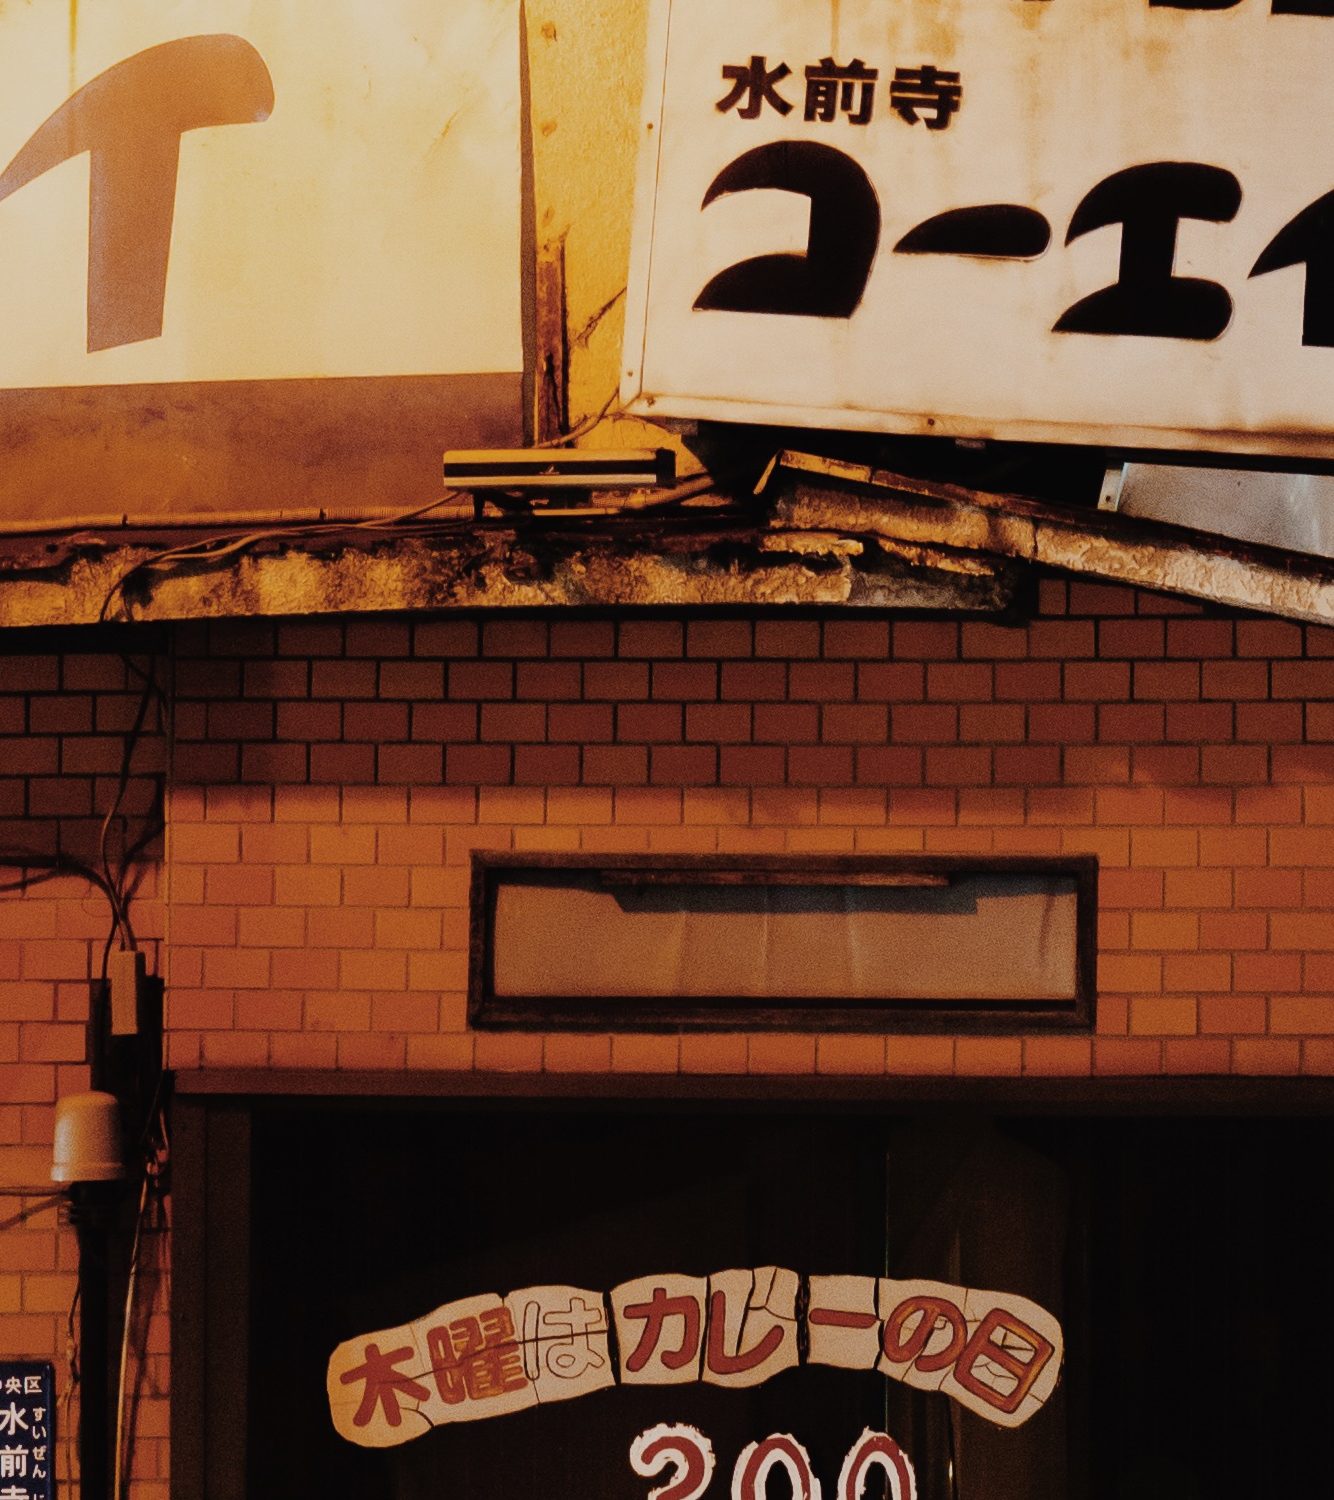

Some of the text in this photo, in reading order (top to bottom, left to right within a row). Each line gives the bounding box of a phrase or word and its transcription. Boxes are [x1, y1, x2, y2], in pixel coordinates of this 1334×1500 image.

[714, 55, 964, 130] 水前寺
[339, 1286, 1055, 1428] 木曜はカレーの日
